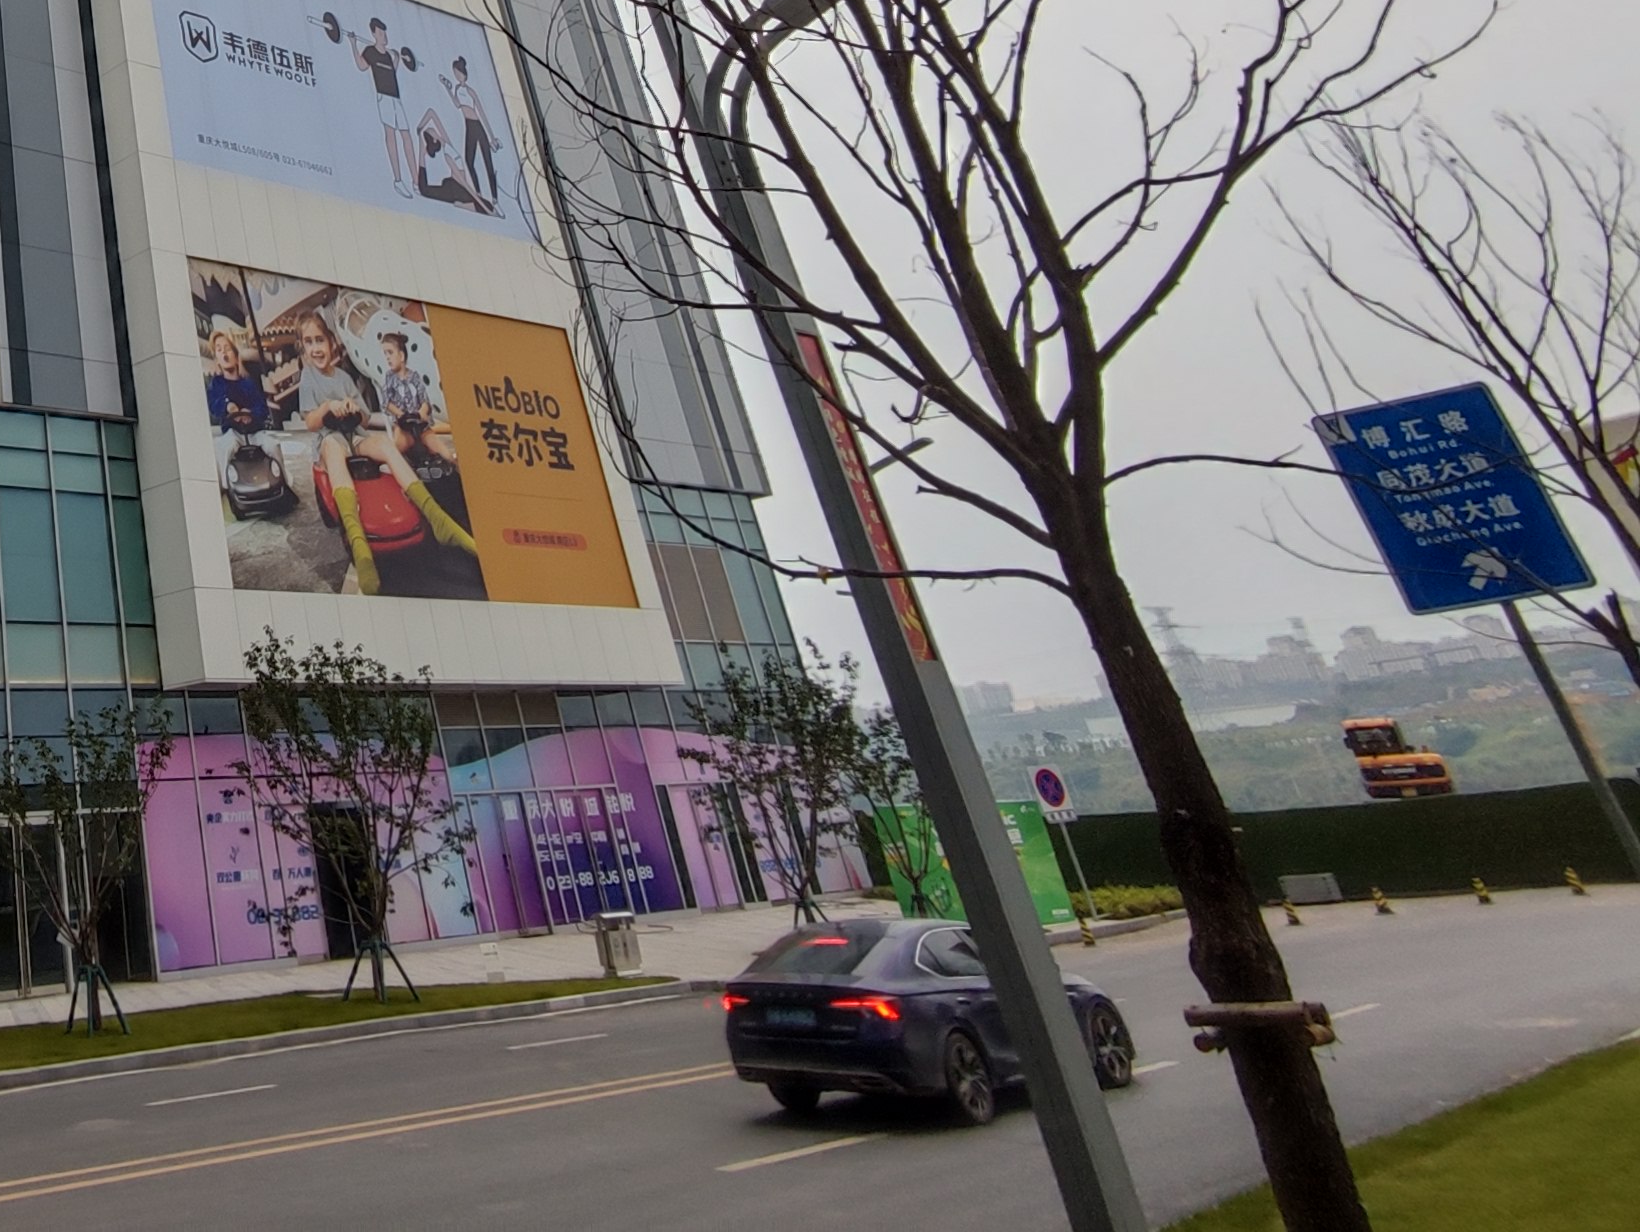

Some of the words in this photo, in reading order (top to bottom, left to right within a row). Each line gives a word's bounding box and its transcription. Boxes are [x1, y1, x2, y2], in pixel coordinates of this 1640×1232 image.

[222, 31, 314, 76] 韦德伍斯
[225, 52, 271, 74] WHYTE
[274, 67, 317, 87] WOOLF
[473, 376, 560, 419] NEOBIO
[481, 418, 575, 471] 奈尔宝
[1362, 410, 1469, 449] 博汇路
[1376, 451, 1495, 490] 同茂大道
[1387, 443, 1435, 460] Bohui
[1399, 492, 1521, 533] 秋成大道
